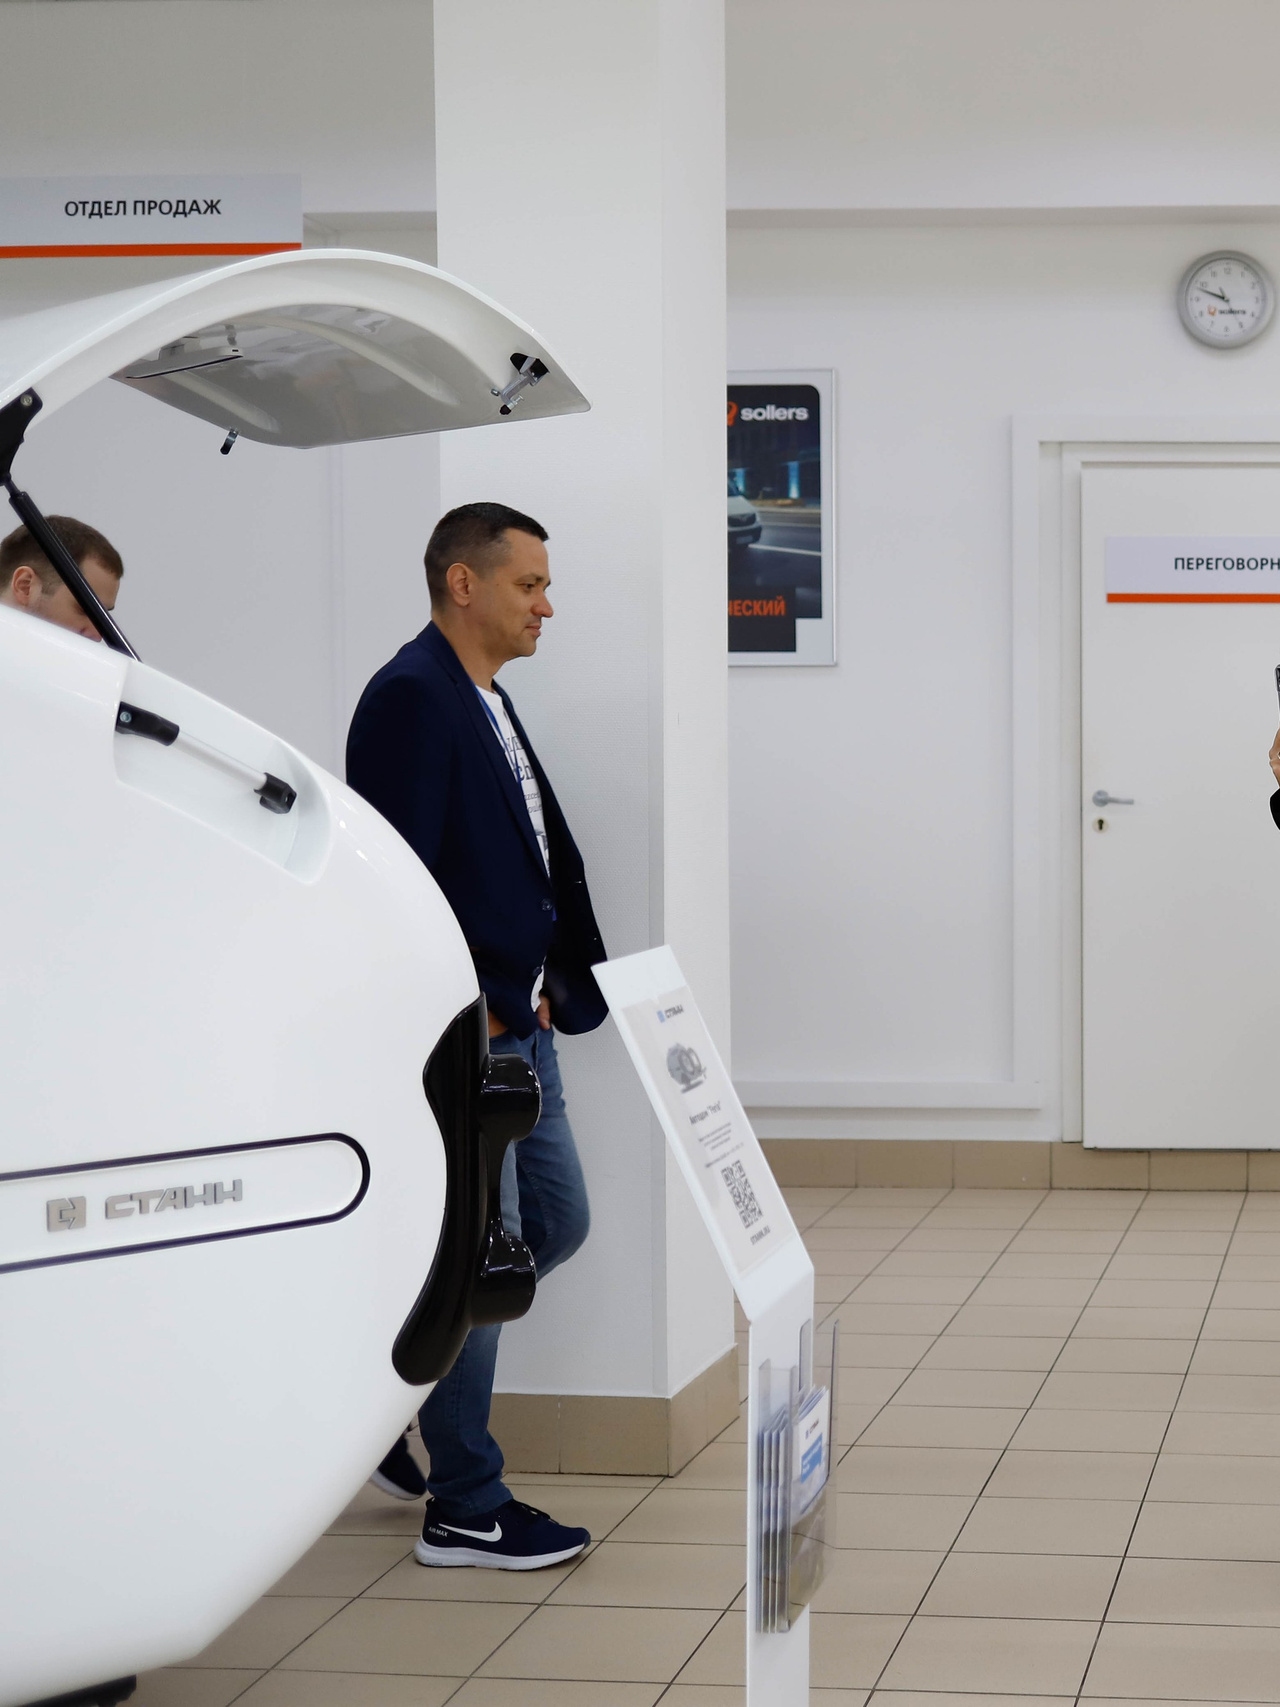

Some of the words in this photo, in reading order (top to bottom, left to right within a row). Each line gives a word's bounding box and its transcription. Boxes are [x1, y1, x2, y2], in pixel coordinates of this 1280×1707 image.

[64, 200, 127, 219] ОТДЕЛ
[132, 199, 222, 218] ПРОДАЖ
[740, 404, 808, 421] sollers
[105, 1178, 243, 1220] СТАНН
